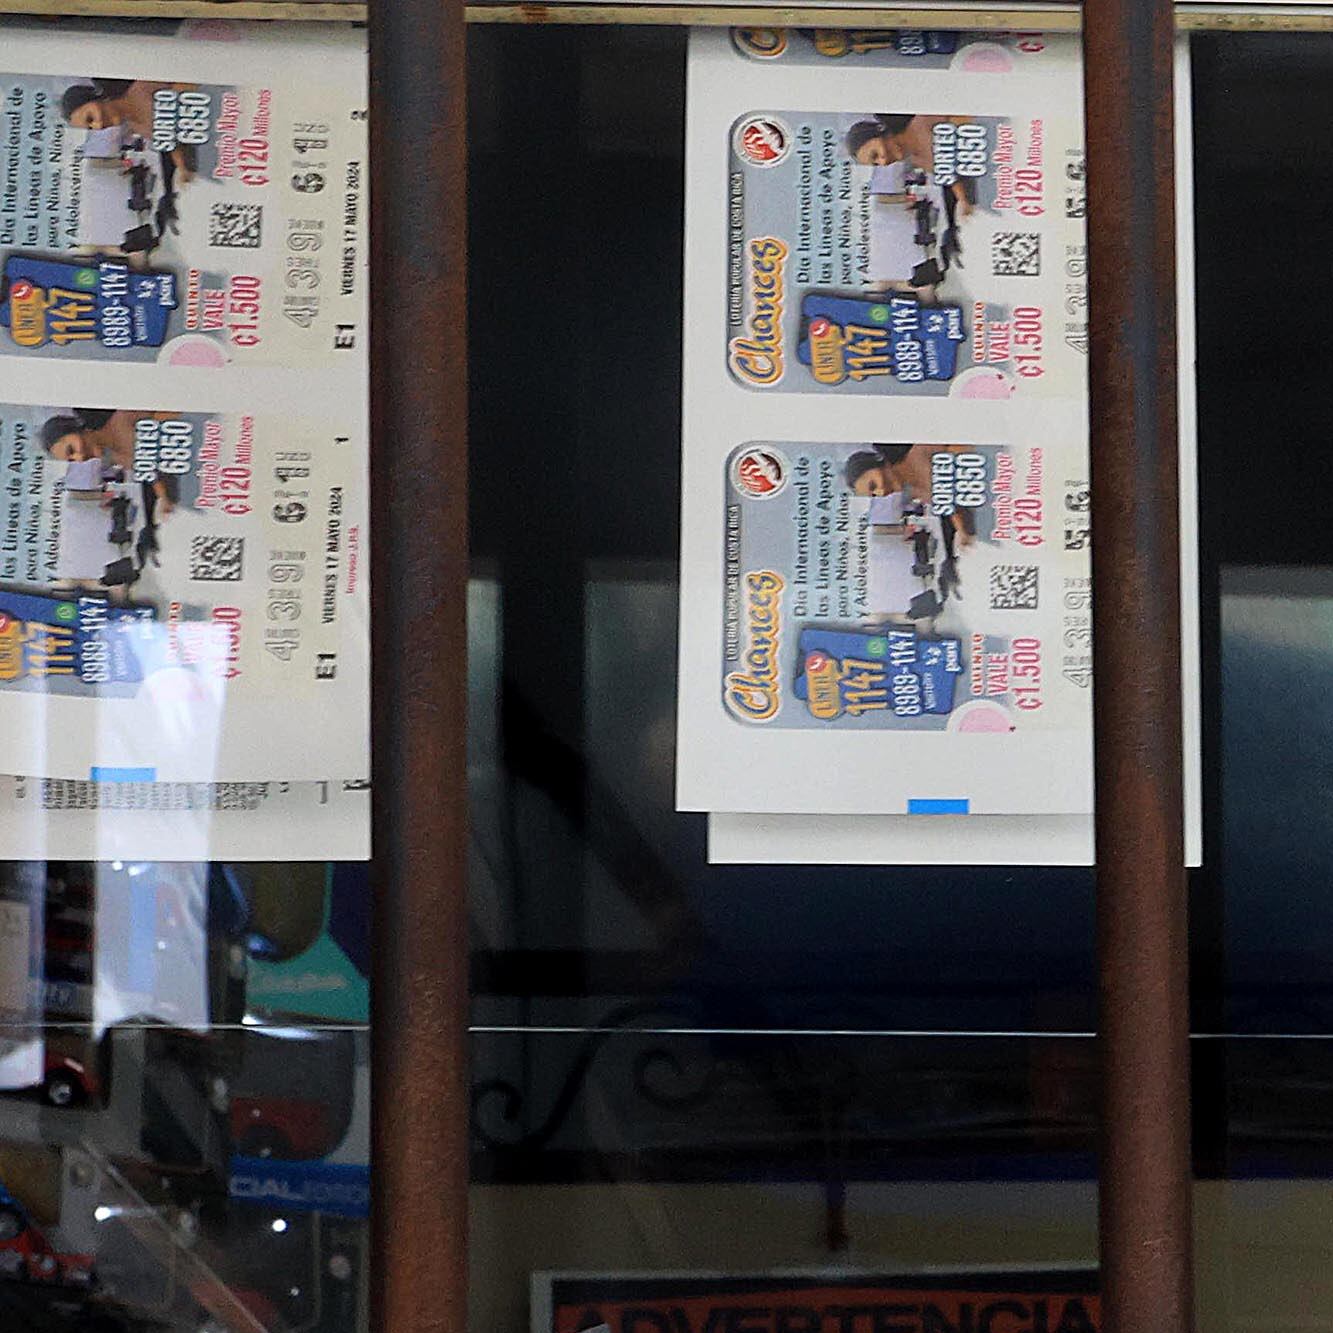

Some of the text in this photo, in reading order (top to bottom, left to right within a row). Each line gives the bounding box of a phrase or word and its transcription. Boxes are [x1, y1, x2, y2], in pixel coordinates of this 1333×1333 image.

[149, 88, 179, 151] SORTEO
[176, 90, 213, 145] 6850
[992, 124, 1017, 164] Mayor
[1027, 117, 1045, 167] Millones
[932, 122, 957, 184] SORTEO
[956, 123, 988, 177] 6850
[46, 287, 100, 345] 1147
[94, 261, 135, 346] 8989-1147
[733, 236, 787, 381] Chances
[844, 324, 892, 381] 1147
[889, 297, 923, 380] 8989-1147
[130, 418, 161, 482] SORTEO
[158, 419, 195, 475] 6850
[930, 452, 955, 514] SORTEO
[955, 452, 987, 506] 6850
[321, 486, 345, 625] VIERNES 17 MAYO 2024
[24, 621, 80, 680] 1147
[730, 570, 784, 716] Chances
[887, 630, 922, 714] 8989-1147
[841, 657, 890, 715] 1147
[988, 652, 1010, 694] VALE
